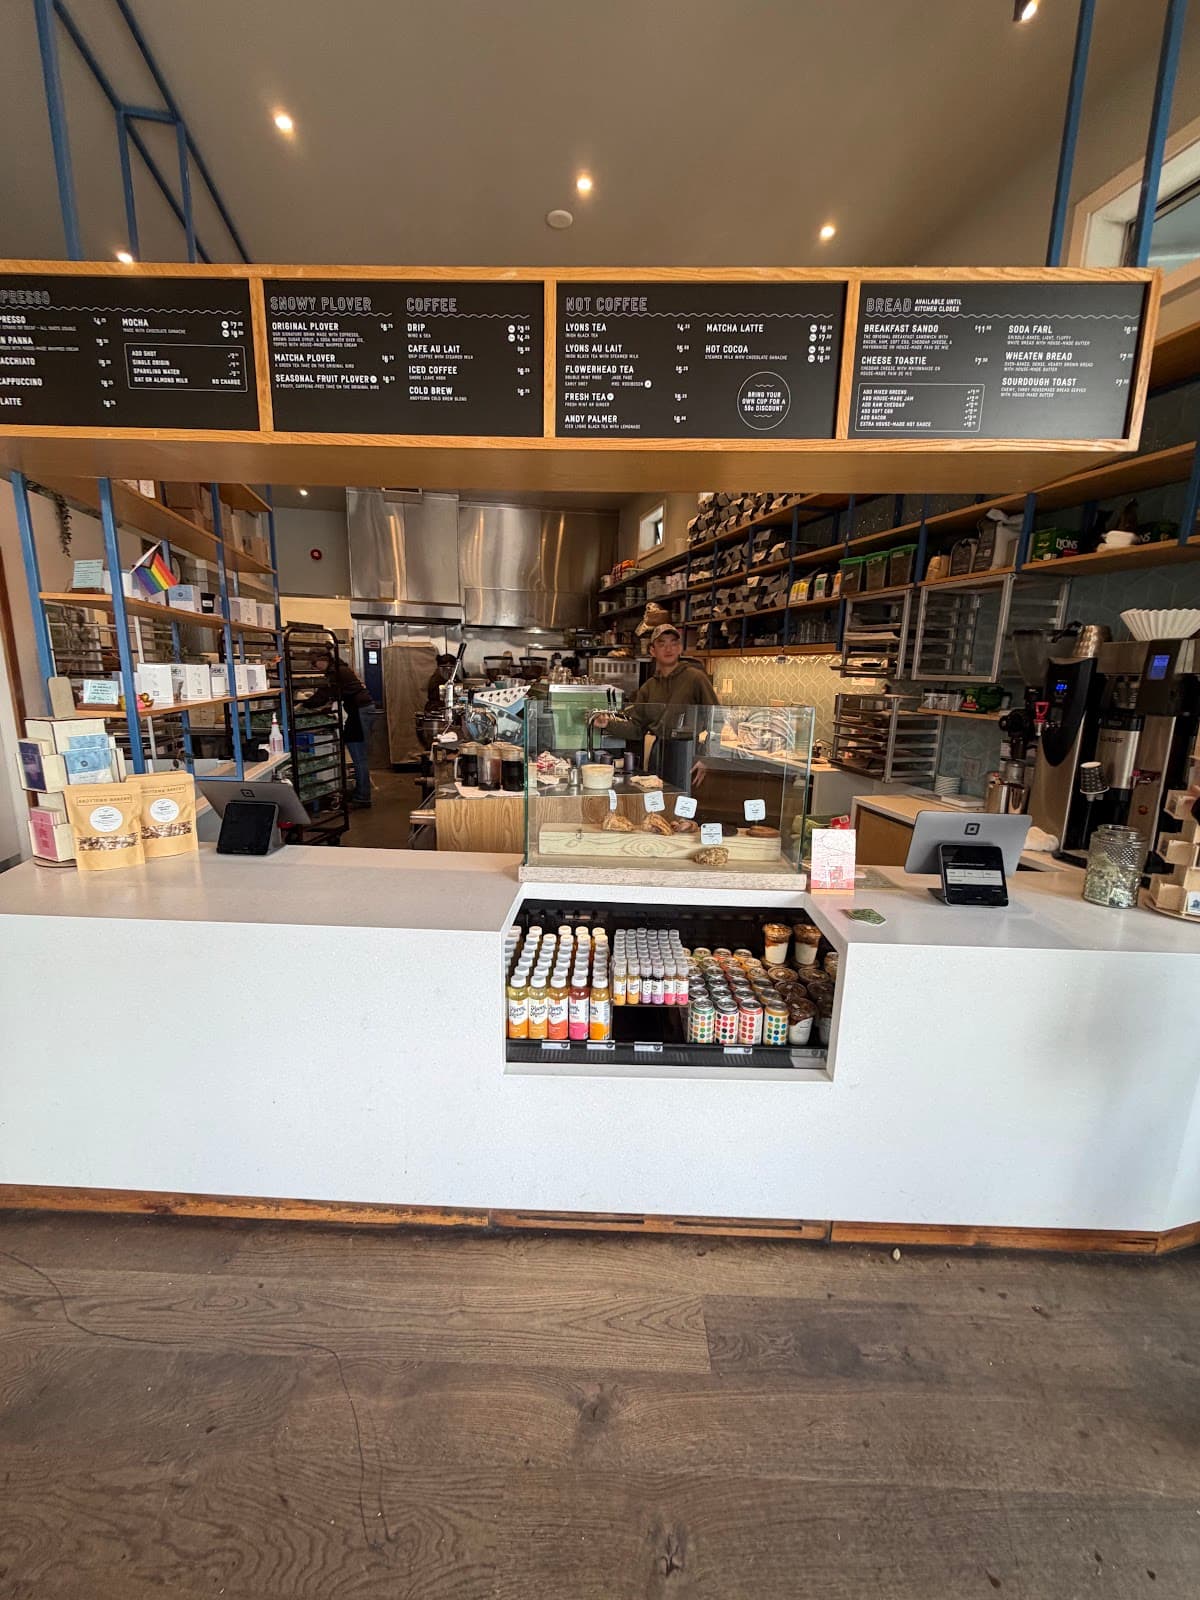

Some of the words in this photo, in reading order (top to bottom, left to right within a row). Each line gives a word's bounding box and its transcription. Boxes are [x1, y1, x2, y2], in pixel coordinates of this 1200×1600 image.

[270, 296, 316, 311] SNOWY
[321, 296, 372, 312] PLOVER
[406, 297, 457, 313] COFFEE
[566, 297, 592, 312] NOT
[596, 297, 648, 312] COFFEE
[866, 298, 912, 313] BREAD
[122, 318, 149, 327] MOCHA
[272, 322, 307, 331] ORIGINAL
[310, 322, 339, 331] PLOVER
[407, 323, 426, 332] DRIP
[565, 323, 590, 332] LYONS
[591, 323, 607, 332] TEA
[706, 323, 738, 333] MATCHA
[740, 324, 764, 333] LATTE
[864, 324, 910, 333] BREAKFAST
[912, 324, 939, 333] SANDO
[1008, 325, 1030, 334] SODA
[1032, 325, 1053, 334] FARL
[7, 336, 34, 345] PANNA
[408, 344, 428, 353] CAFE
[430, 345, 441, 353] AU
[443, 345, 460, 353] LAIT
[565, 344, 590, 353] LYONS
[591, 344, 603, 353] AU
[605, 344, 622, 353] LAIT
[705, 345, 721, 353] HOT
[723, 345, 749, 354] COCOA
[274, 354, 305, 362] MATCHA
[307, 354, 336, 362] PLOVER
[861, 356, 892, 365] CHEESE
[895, 357, 927, 365] TOASTIE
[1005, 352, 1043, 361] WHEATEN
[1046, 352, 1073, 361] BREAD
[408, 366, 426, 374] ICED
[429, 366, 458, 375] COFFEE
[565, 365, 617, 374] FLOWERHEAD
[619, 365, 634, 374] TEA
[275, 374, 314, 383] SEASONAL
[316, 375, 338, 383] FRUIT
[340, 375, 370, 383] PLOVER
[1002, 377, 1050, 386] SOURDOUGH
[1052, 378, 1077, 386] TOAST
[409, 386, 429, 395] COLD
[431, 387, 453, 395] BREW
[564, 392, 589, 401] FRESH
[595, 393, 607, 401] TEA
[0, 397, 22, 406] LATTE
[564, 415, 585, 423] ANDY
[587, 415, 618, 423] PALMER
[1056, 537, 1078, 550] LYONS
